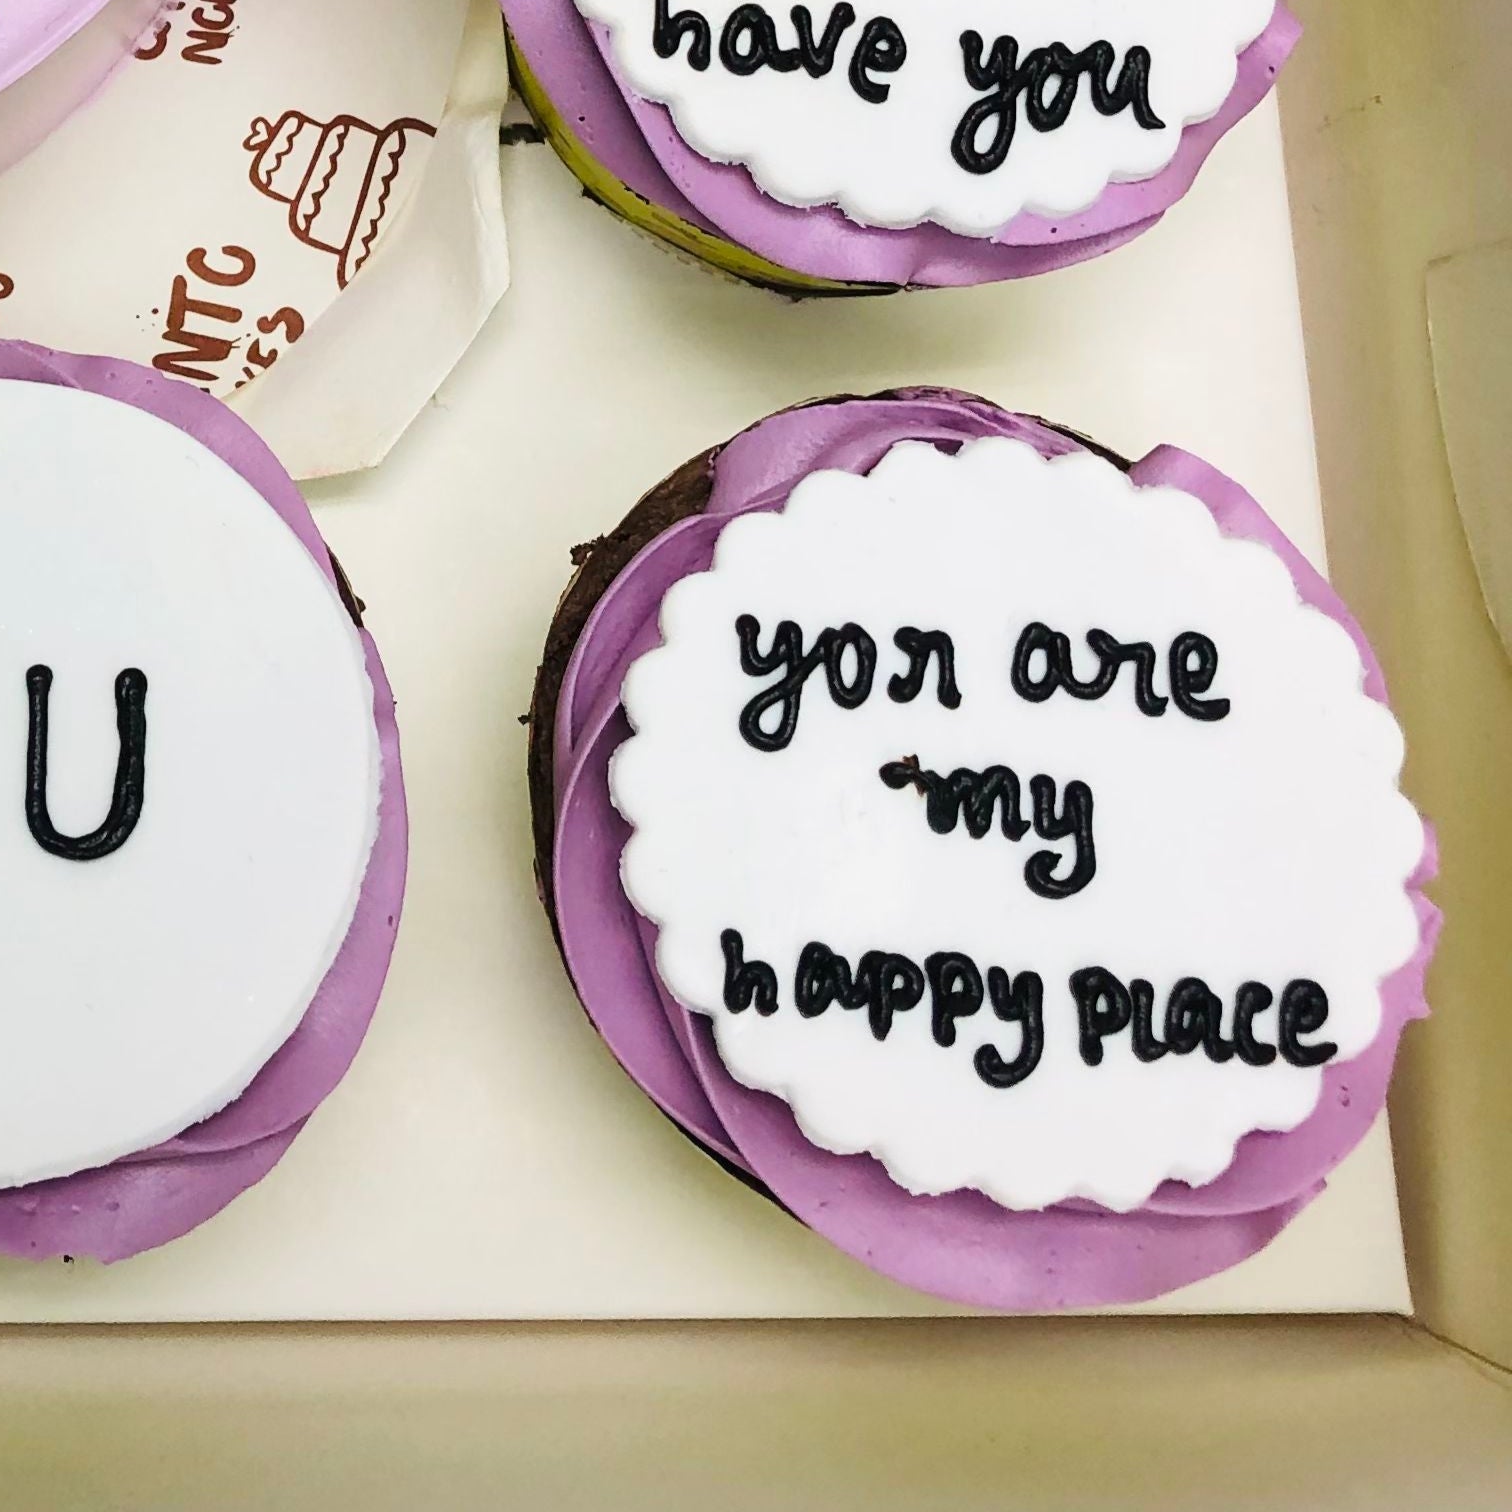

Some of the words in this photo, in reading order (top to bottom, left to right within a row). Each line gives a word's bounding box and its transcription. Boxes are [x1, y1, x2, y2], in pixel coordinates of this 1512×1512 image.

[950, 29, 1166, 175] you
[1010, 621, 1231, 722] are
[878, 754, 1097, 900] my
[720, 928, 1044, 1089] happy
[1068, 966, 1338, 1068] place
